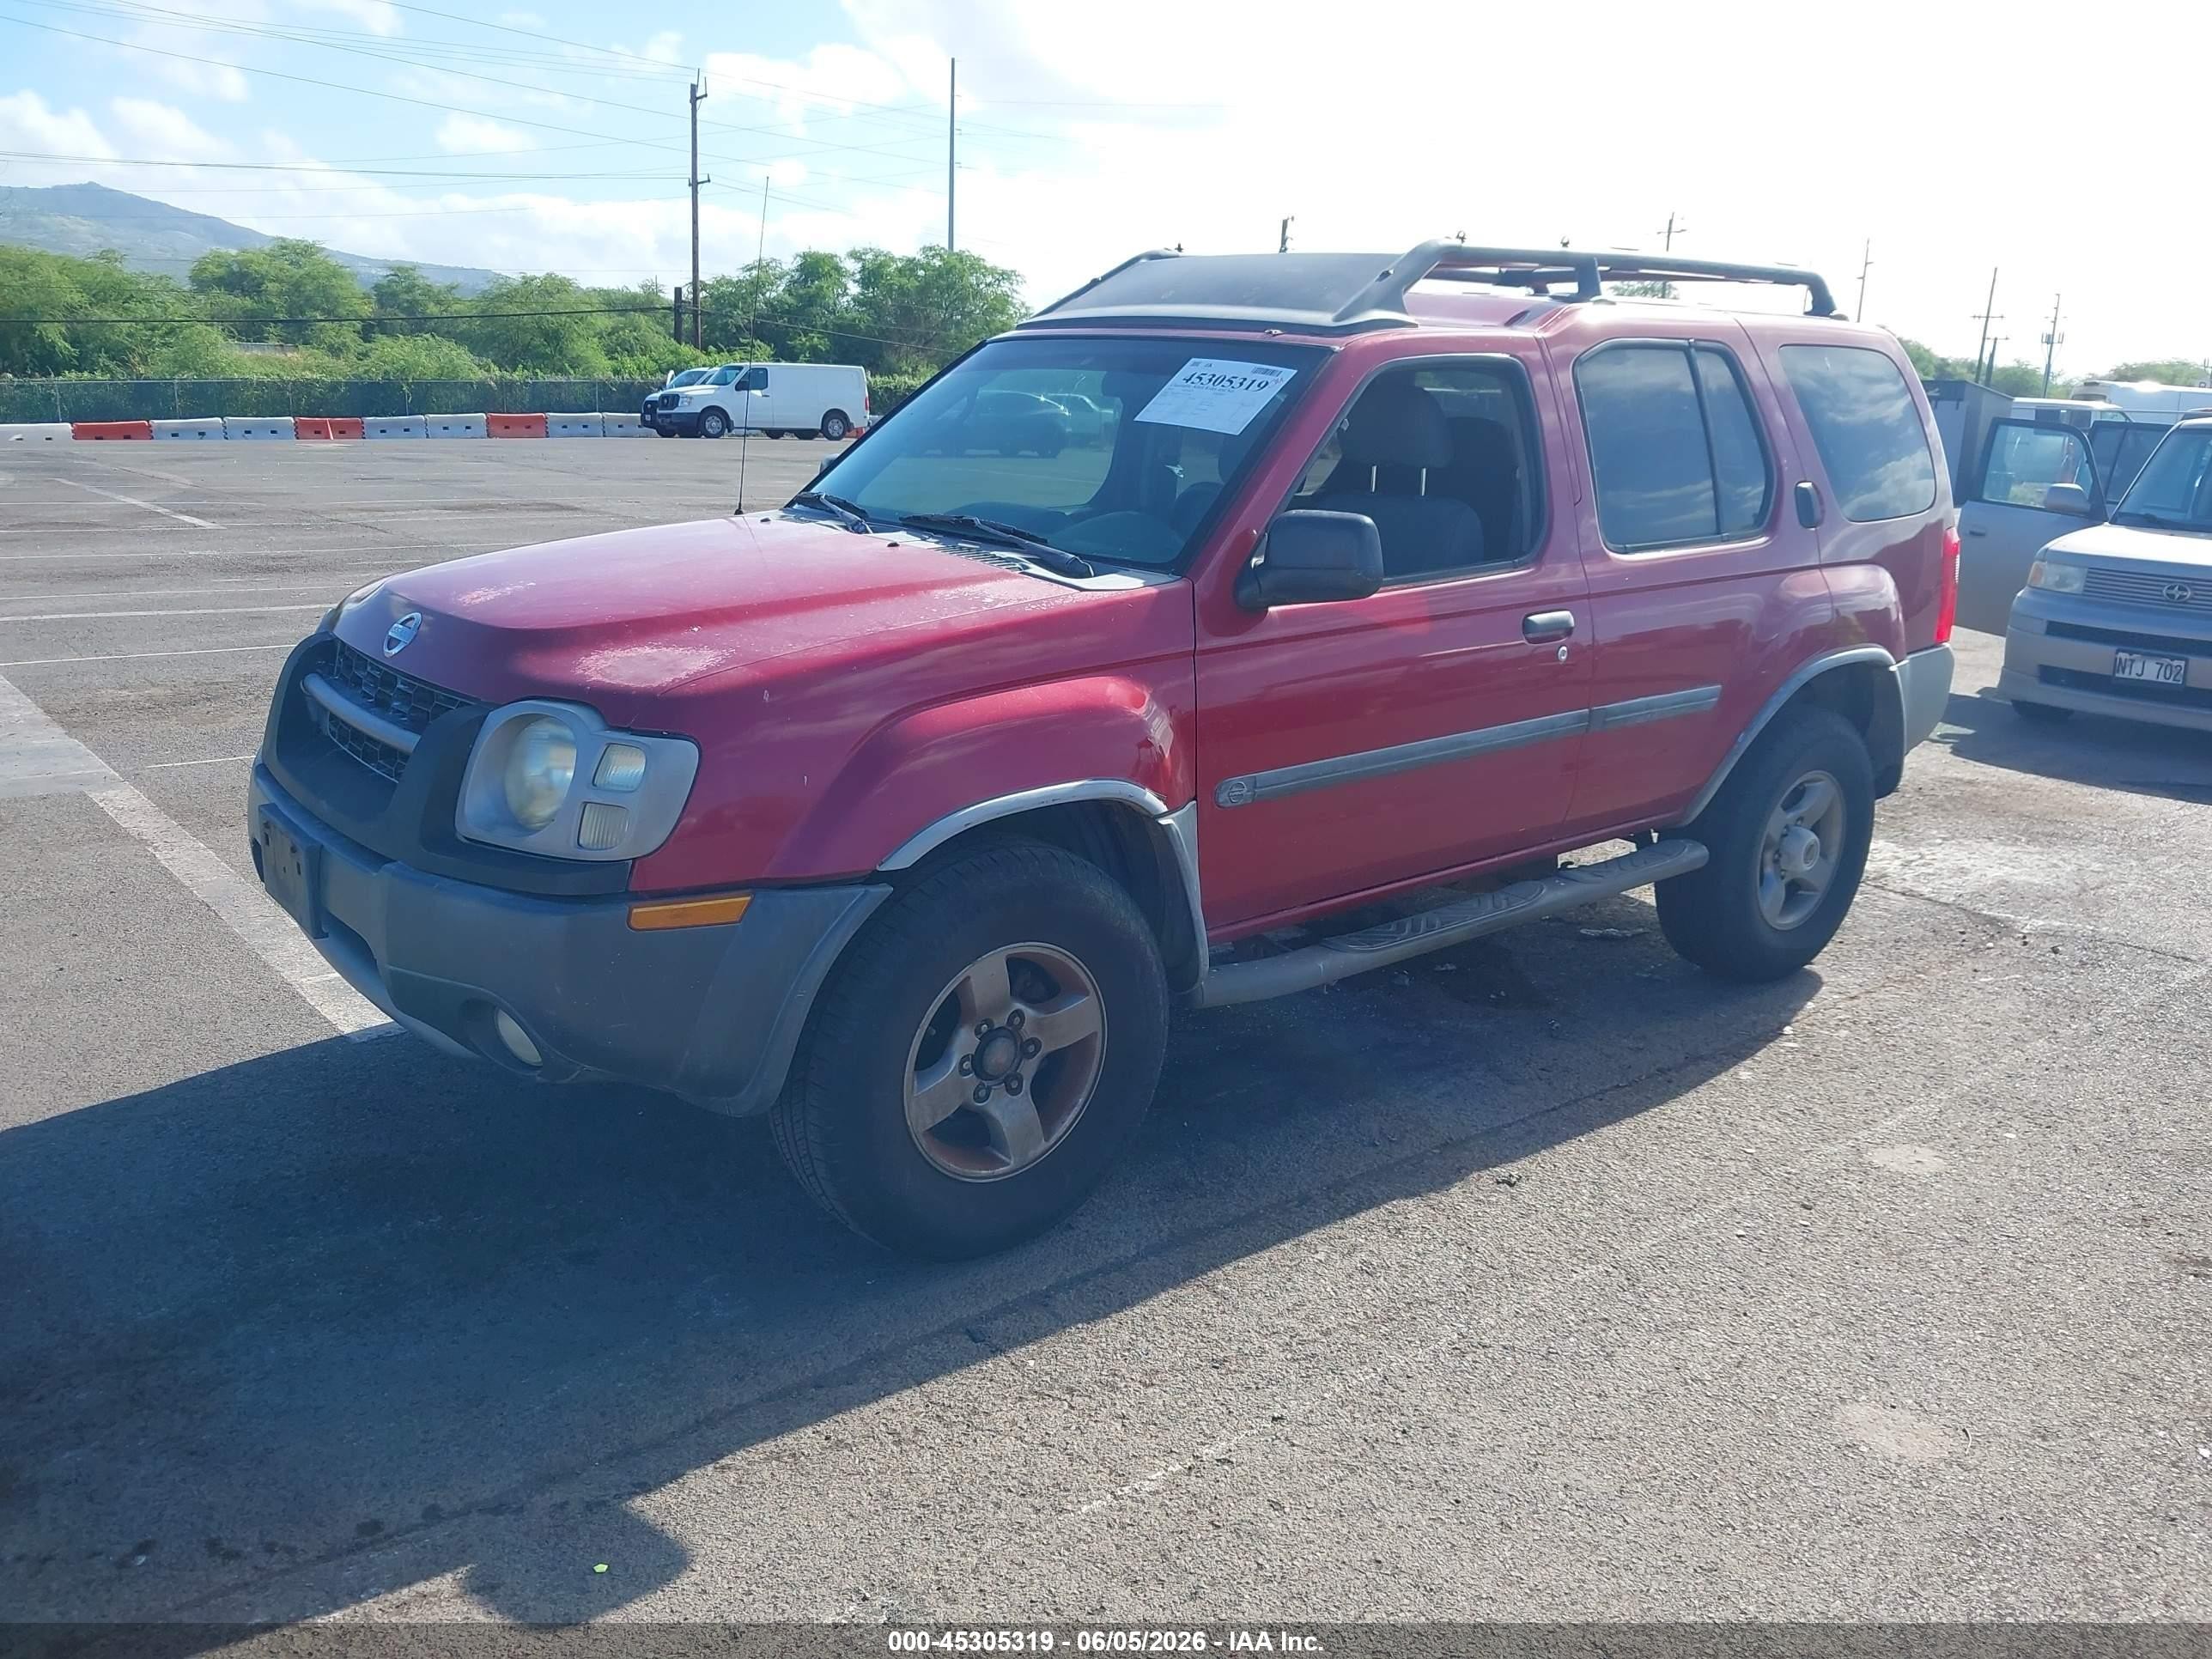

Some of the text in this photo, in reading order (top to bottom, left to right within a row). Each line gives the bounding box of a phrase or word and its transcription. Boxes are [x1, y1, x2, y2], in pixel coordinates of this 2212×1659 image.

[1182, 372, 1269, 392] 45305319
[2117, 657, 2182, 682] NTJ 702
